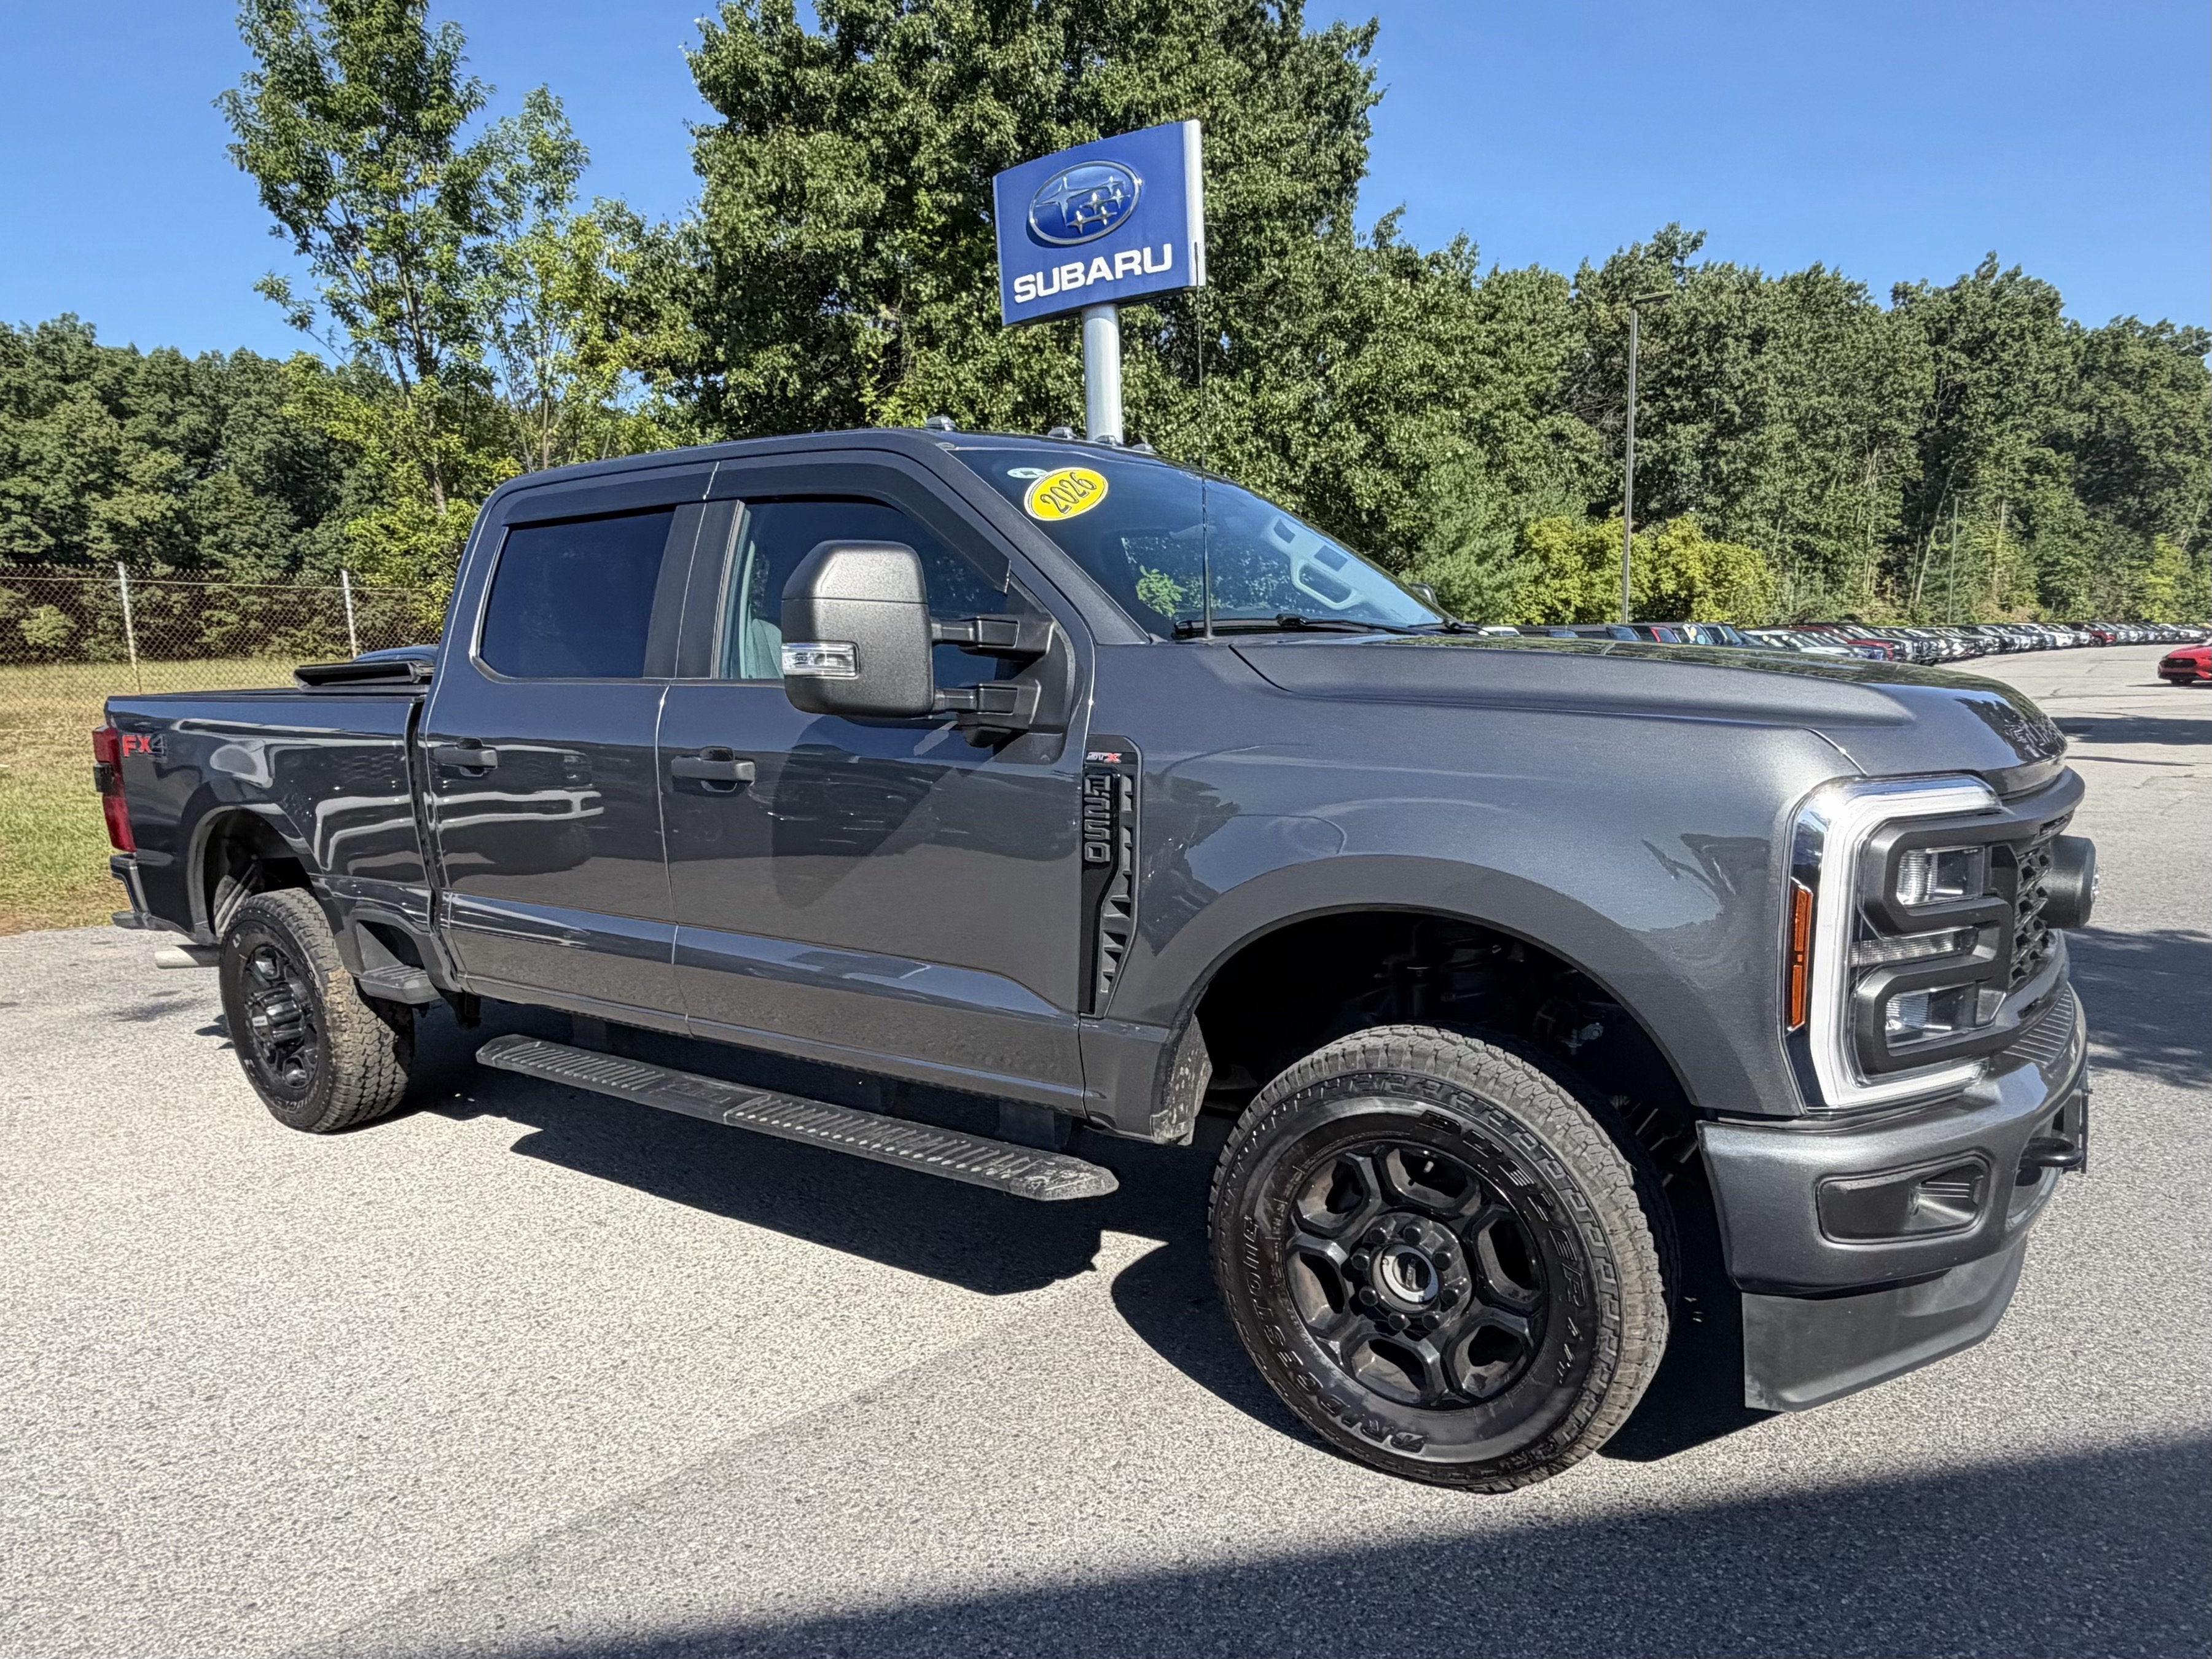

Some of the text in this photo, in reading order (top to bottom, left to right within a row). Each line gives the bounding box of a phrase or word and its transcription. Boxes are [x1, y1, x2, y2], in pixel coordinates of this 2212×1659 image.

[1014, 243, 1172, 303] SUBARU
[1040, 472, 1096, 514] 2026
[122, 733, 168, 763] FX4
[1243, 1214, 1429, 1453] BRIDGESTONE
